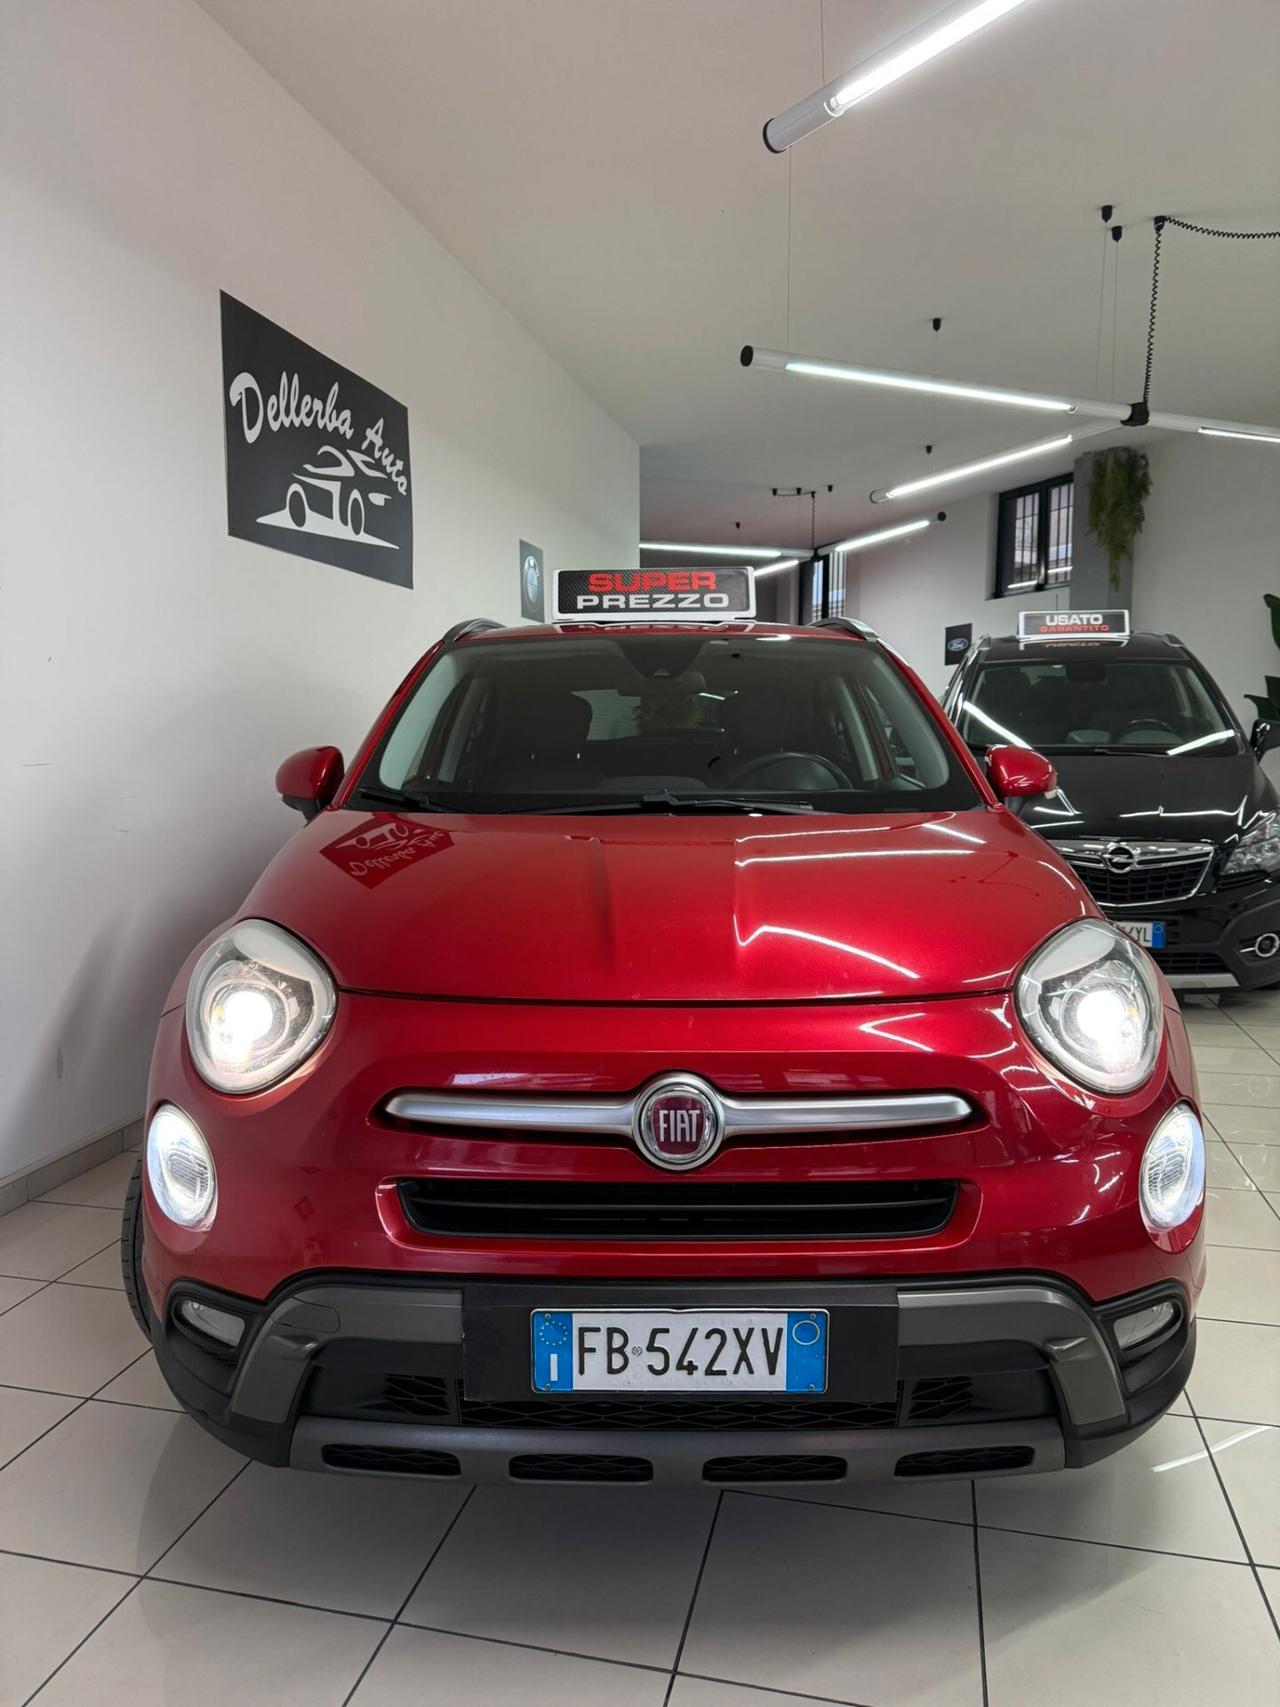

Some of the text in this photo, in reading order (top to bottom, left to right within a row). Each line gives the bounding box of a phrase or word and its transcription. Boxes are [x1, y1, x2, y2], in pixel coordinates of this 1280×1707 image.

[229, 371, 407, 495] Dellerba Auto
[587, 572, 716, 592] SUPER
[576, 594, 729, 609] PREZZO
[1045, 614, 1104, 626] USATO
[1040, 625, 1109, 633] GARANTITO
[659, 1109, 701, 1143] FIAT
